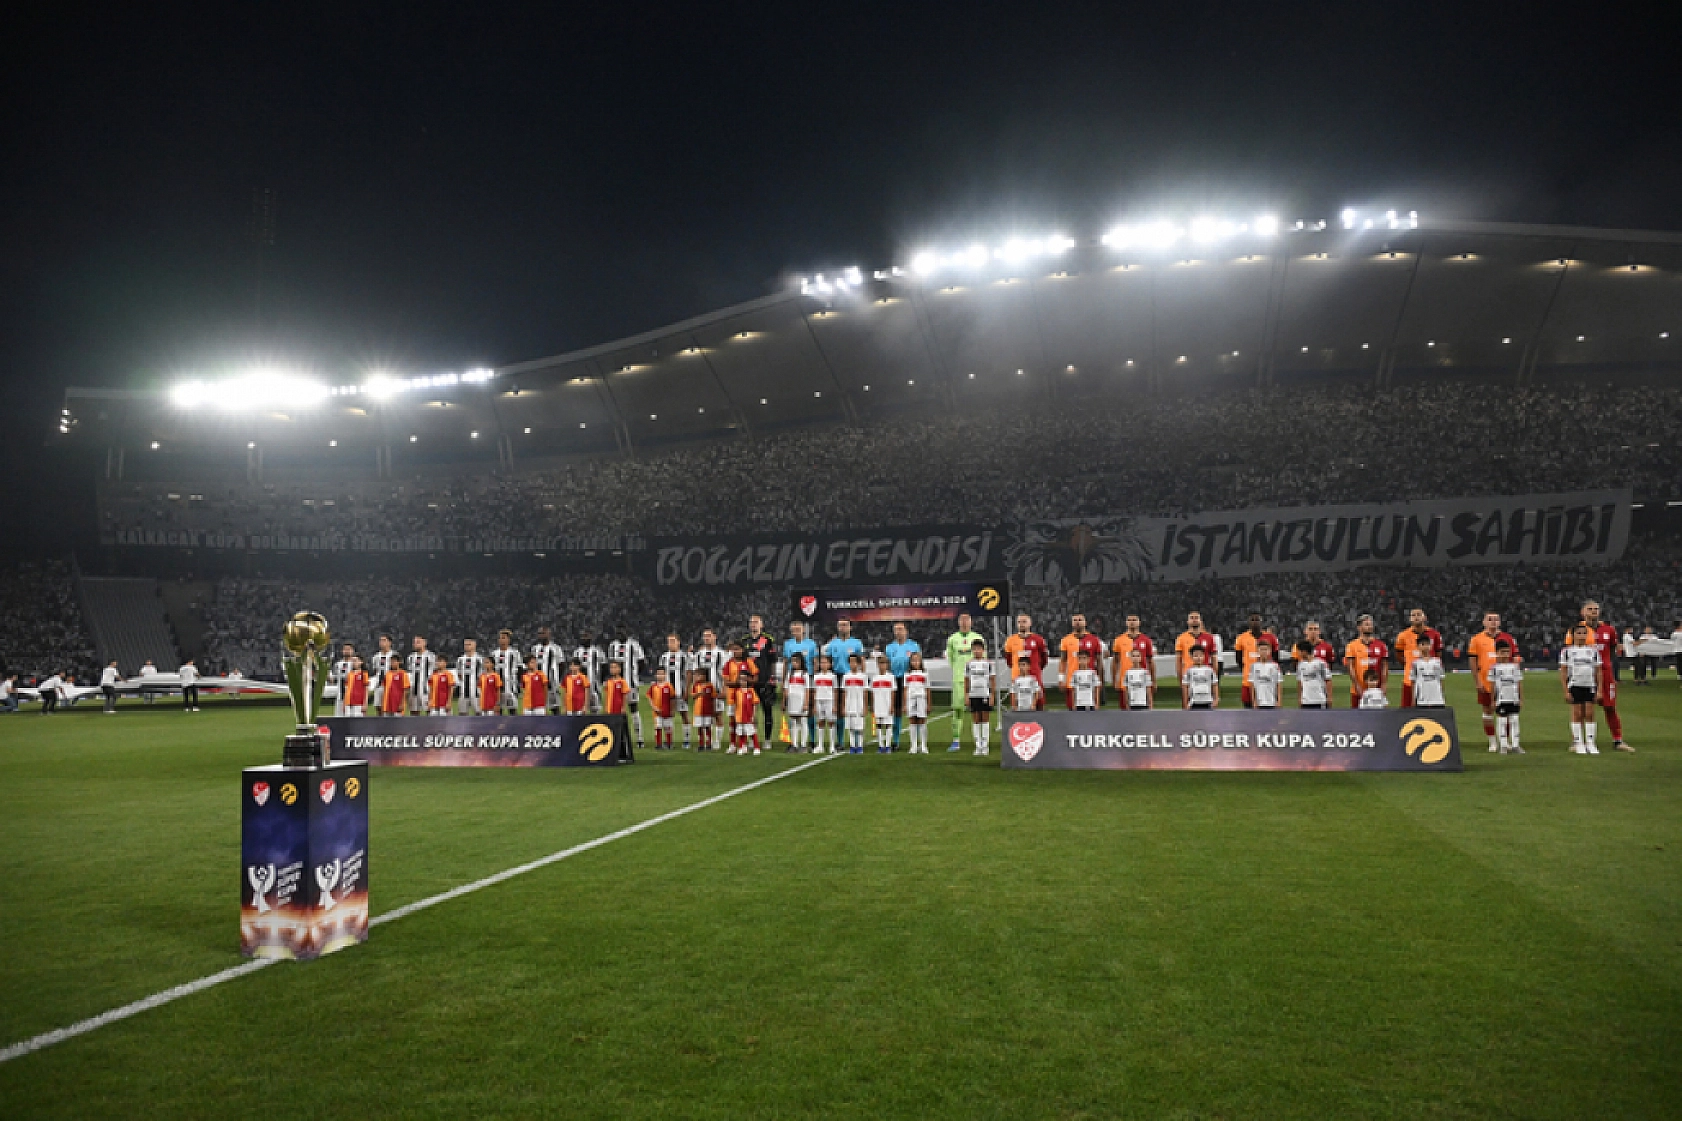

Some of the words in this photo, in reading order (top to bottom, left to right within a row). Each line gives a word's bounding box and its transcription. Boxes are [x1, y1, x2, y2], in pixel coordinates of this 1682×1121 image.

[824, 531, 992, 578] EFENDİSİ
[826, 600, 875, 609] TURKCELL
[914, 596, 941, 606] KUPA
[942, 595, 967, 604] 2024
[344, 735, 418, 748] TURKCELL
[424, 733, 474, 748] SÜPER
[477, 735, 519, 748] KUPA
[523, 735, 562, 748] 2024
[1066, 734, 1173, 748] TURKCELL
[1179, 729, 1250, 748] SÜPER
[1257, 734, 1316, 748] KUPA
[1322, 734, 1376, 748] 2024
